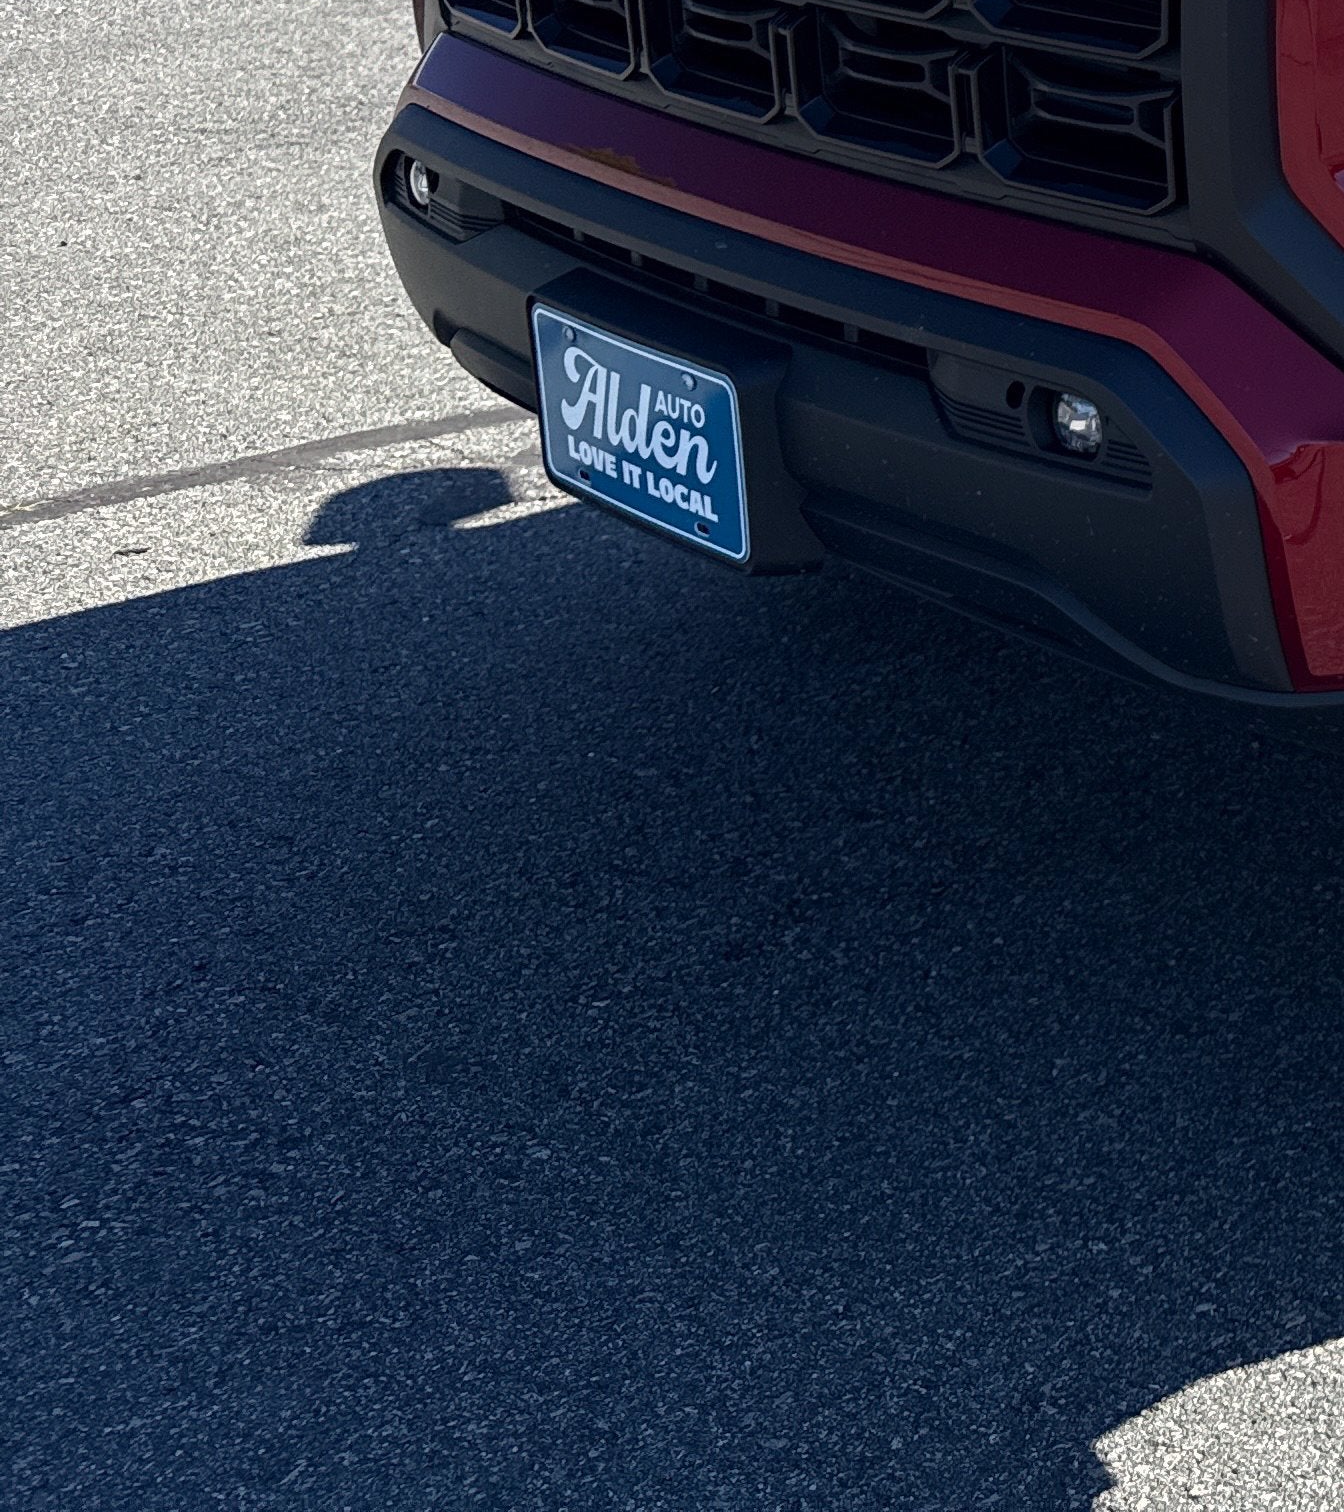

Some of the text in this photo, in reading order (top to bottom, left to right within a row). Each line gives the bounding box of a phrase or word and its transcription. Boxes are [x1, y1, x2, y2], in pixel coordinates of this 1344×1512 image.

[560, 345, 718, 485] Alden
[653, 389, 706, 429] AUTO
[567, 434, 719, 523] LOVE IT LOCAL
